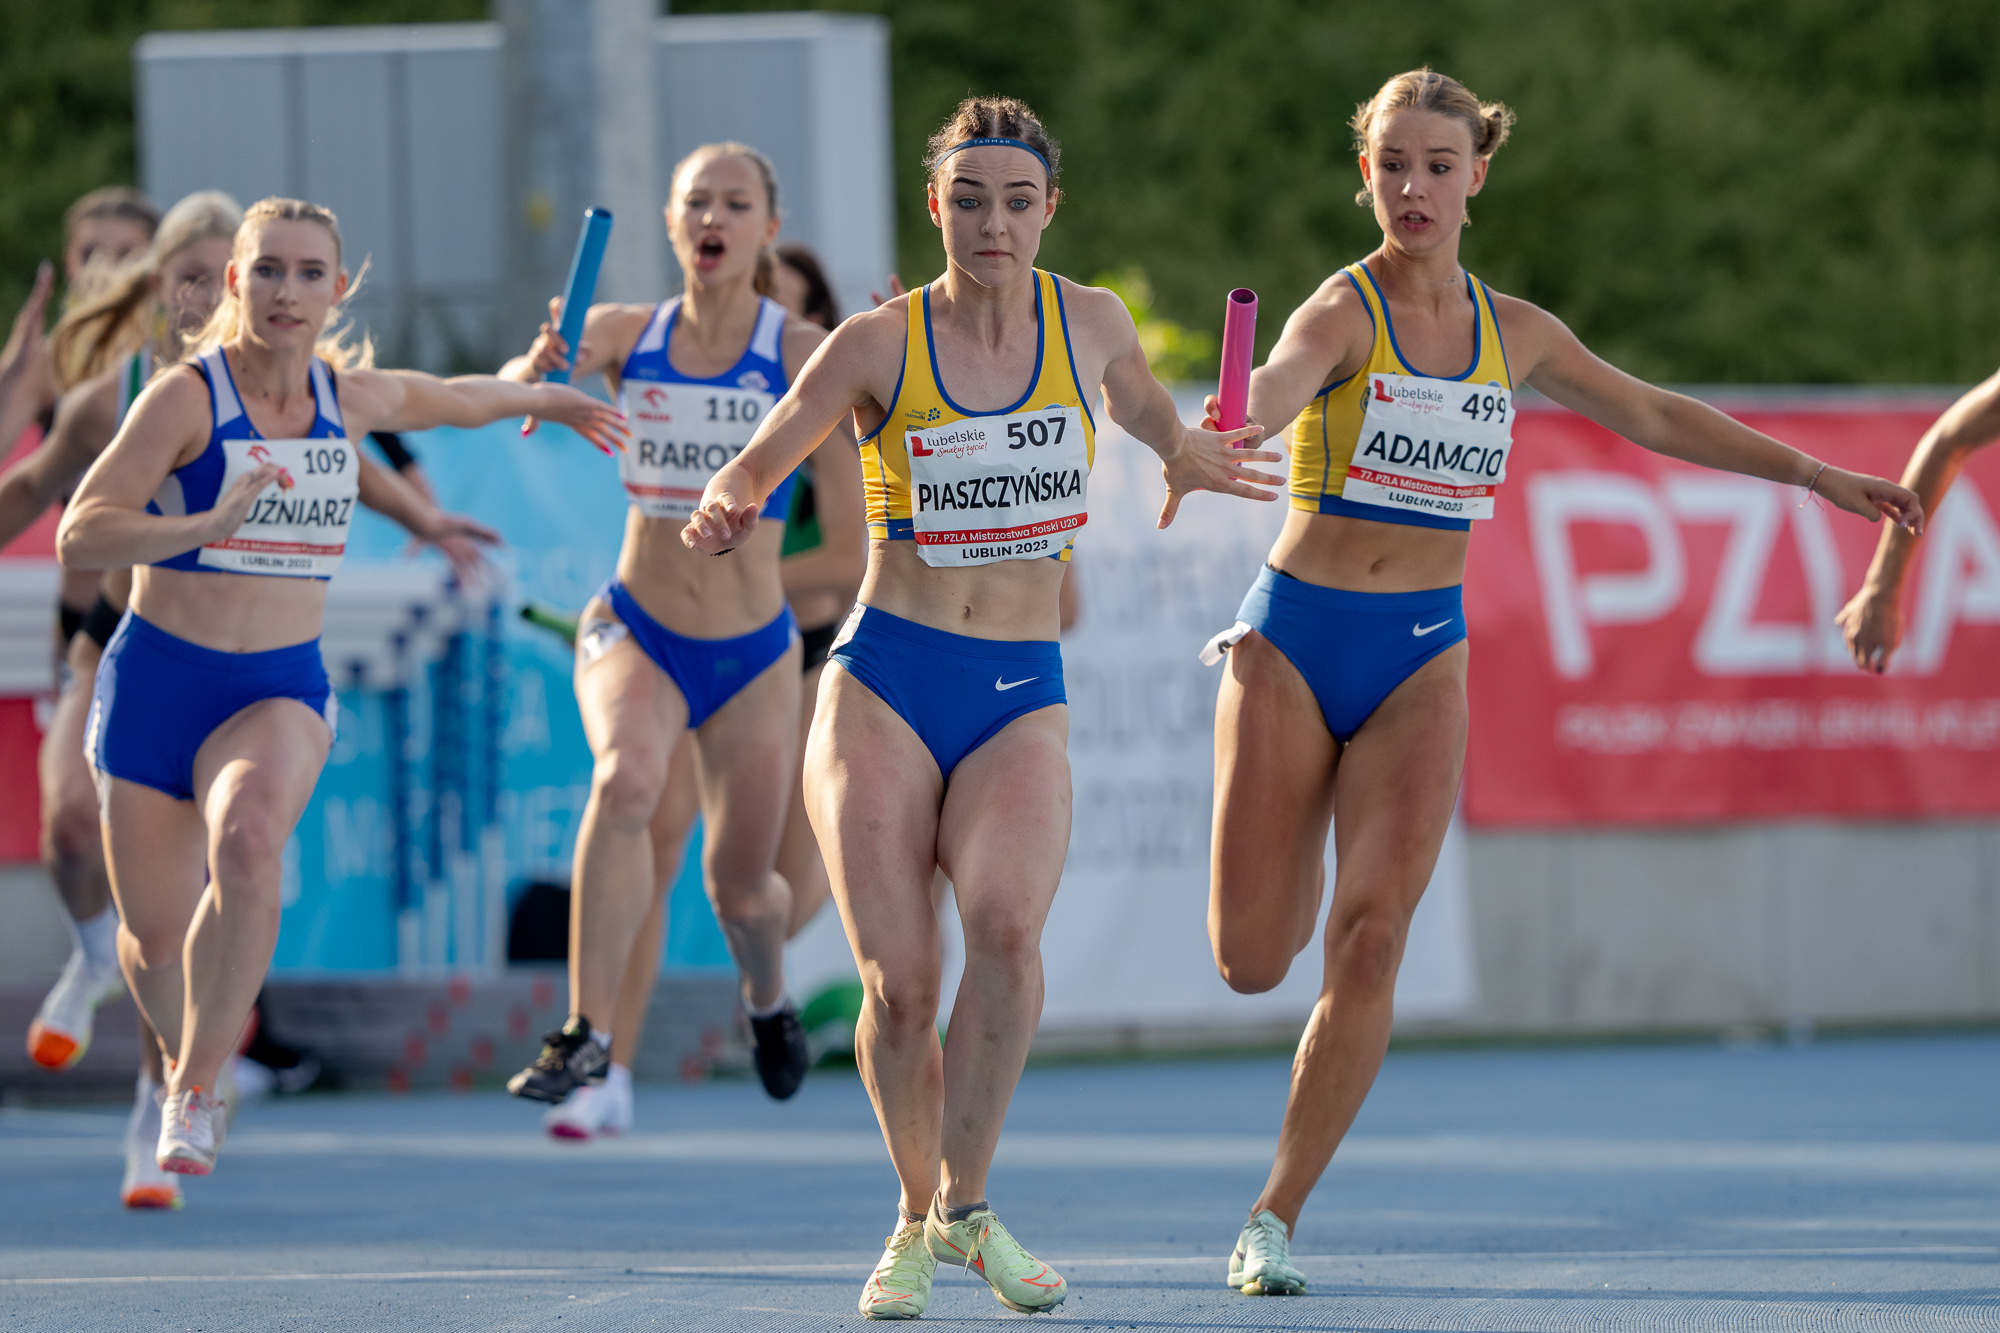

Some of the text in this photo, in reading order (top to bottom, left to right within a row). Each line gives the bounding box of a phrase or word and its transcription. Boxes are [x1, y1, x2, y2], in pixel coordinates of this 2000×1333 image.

[705, 396, 760, 423] 110
[1461, 393, 1507, 424] 499
[1007, 416, 1067, 450] 507
[304, 448, 347, 474] 109
[1363, 430, 1503, 477] ADAMCIO
[918, 466, 1082, 512] PIASZCZYŃSKA
[1360, 469, 1374, 481] 77.
[1375, 473, 1398, 487] PZLA
[1400, 478, 1454, 496] Mistrzostwa
[1389, 491, 1463, 512] LUBLIN 2023
[927, 517, 1078, 543] 77. PZLA Mistrzostwa Polski U20
[241, 554, 286, 568] LUBLIN
[962, 539, 1048, 559] LUBLIN 2023
